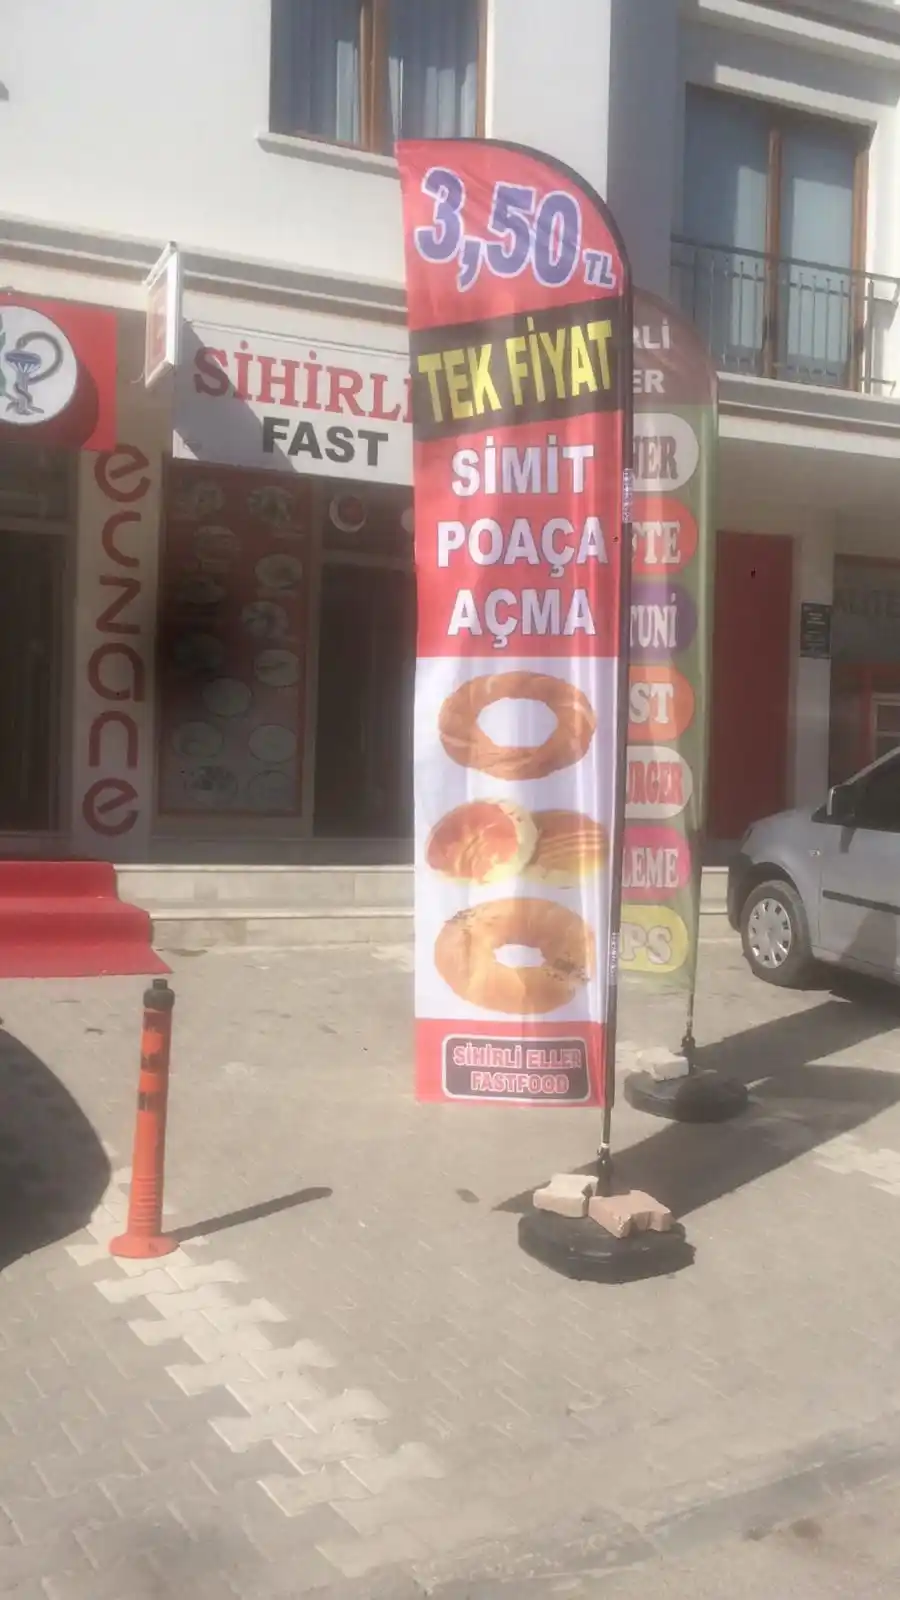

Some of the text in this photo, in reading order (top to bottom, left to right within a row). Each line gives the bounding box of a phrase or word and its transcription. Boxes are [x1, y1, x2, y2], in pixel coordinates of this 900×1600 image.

[415, 167, 616, 292] 3,50 TL
[417, 316, 612, 424] TEK FİYAT
[262, 416, 389, 467] FAST
[451, 435, 595, 497] SİMİT
[437, 516, 609, 578] POAÇA
[82, 443, 151, 838] eczane
[447, 588, 597, 649] AÇMA
[452, 1042, 582, 1070] SİHİRLİ ELLER
[470, 1071, 570, 1094] FASTFOOD
